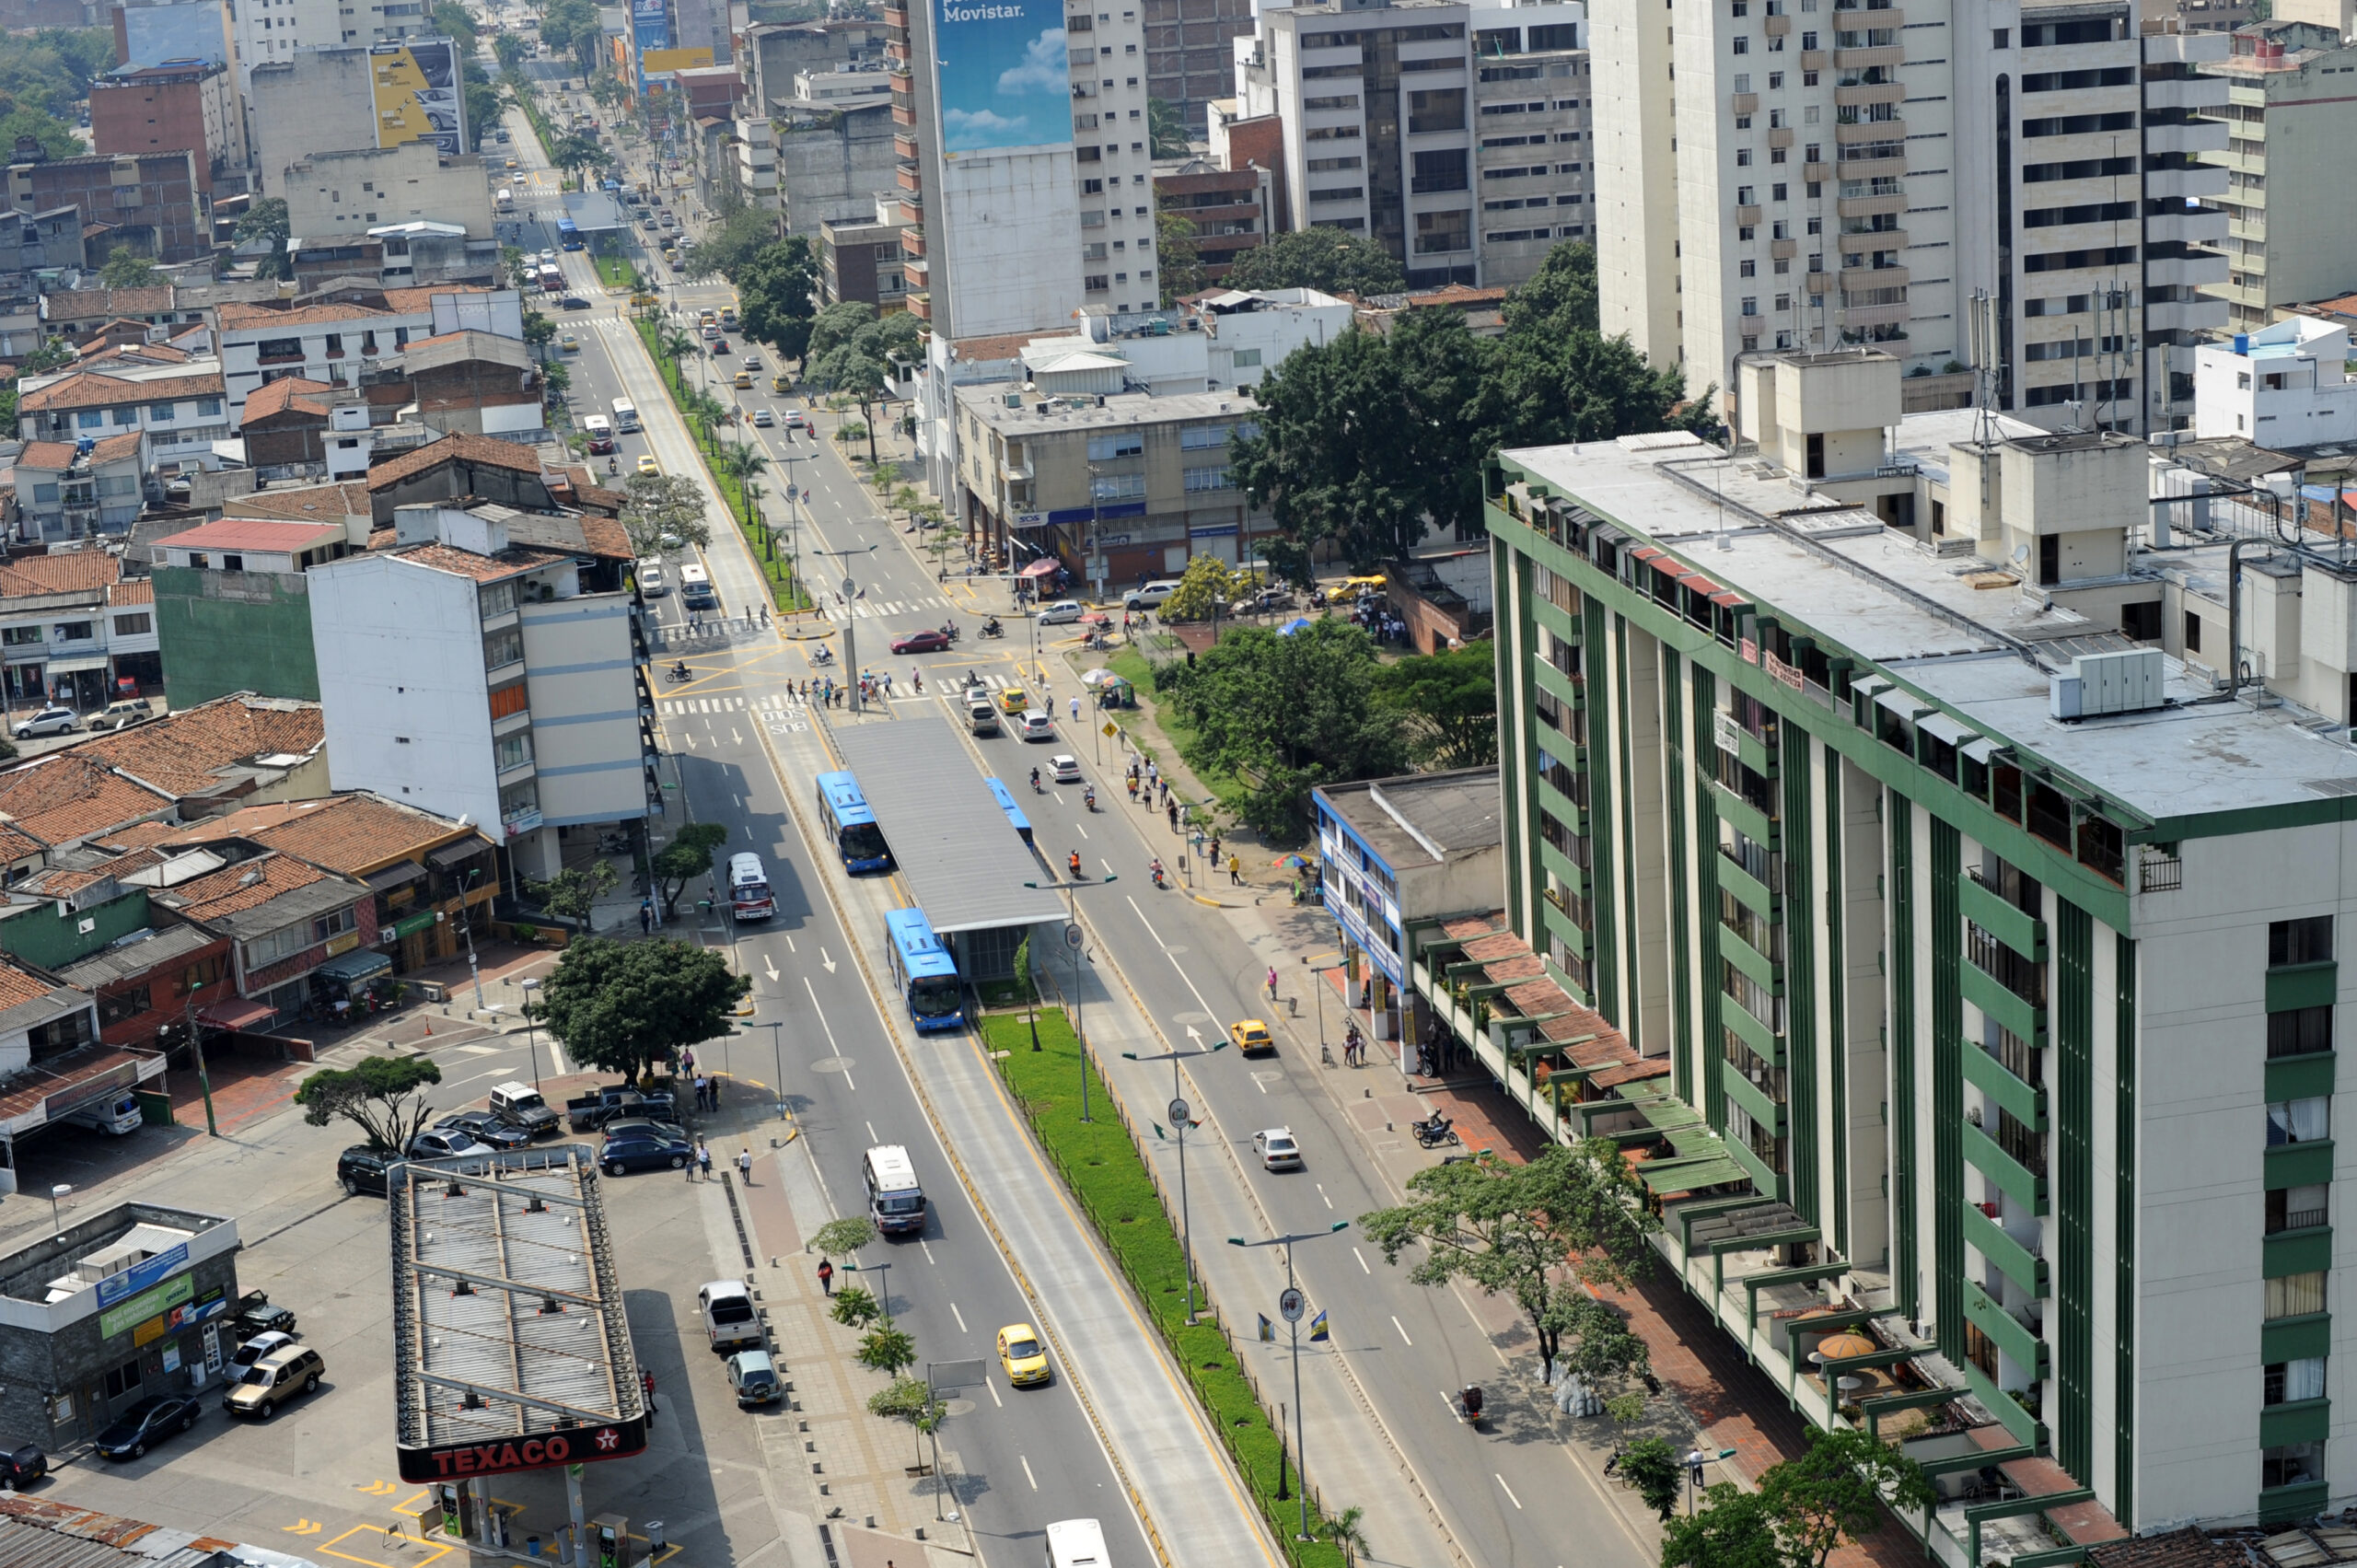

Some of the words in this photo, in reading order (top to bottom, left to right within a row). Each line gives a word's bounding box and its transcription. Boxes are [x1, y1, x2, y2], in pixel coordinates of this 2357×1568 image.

[943, 4, 1025, 23] Movistar.
[1018, 514, 1041, 523] SOS
[761, 708, 807, 722] SOLO
[770, 721, 808, 735] BUS
[165, 1284, 188, 1305] gazel
[432, 1435, 571, 1476] TEXACO
